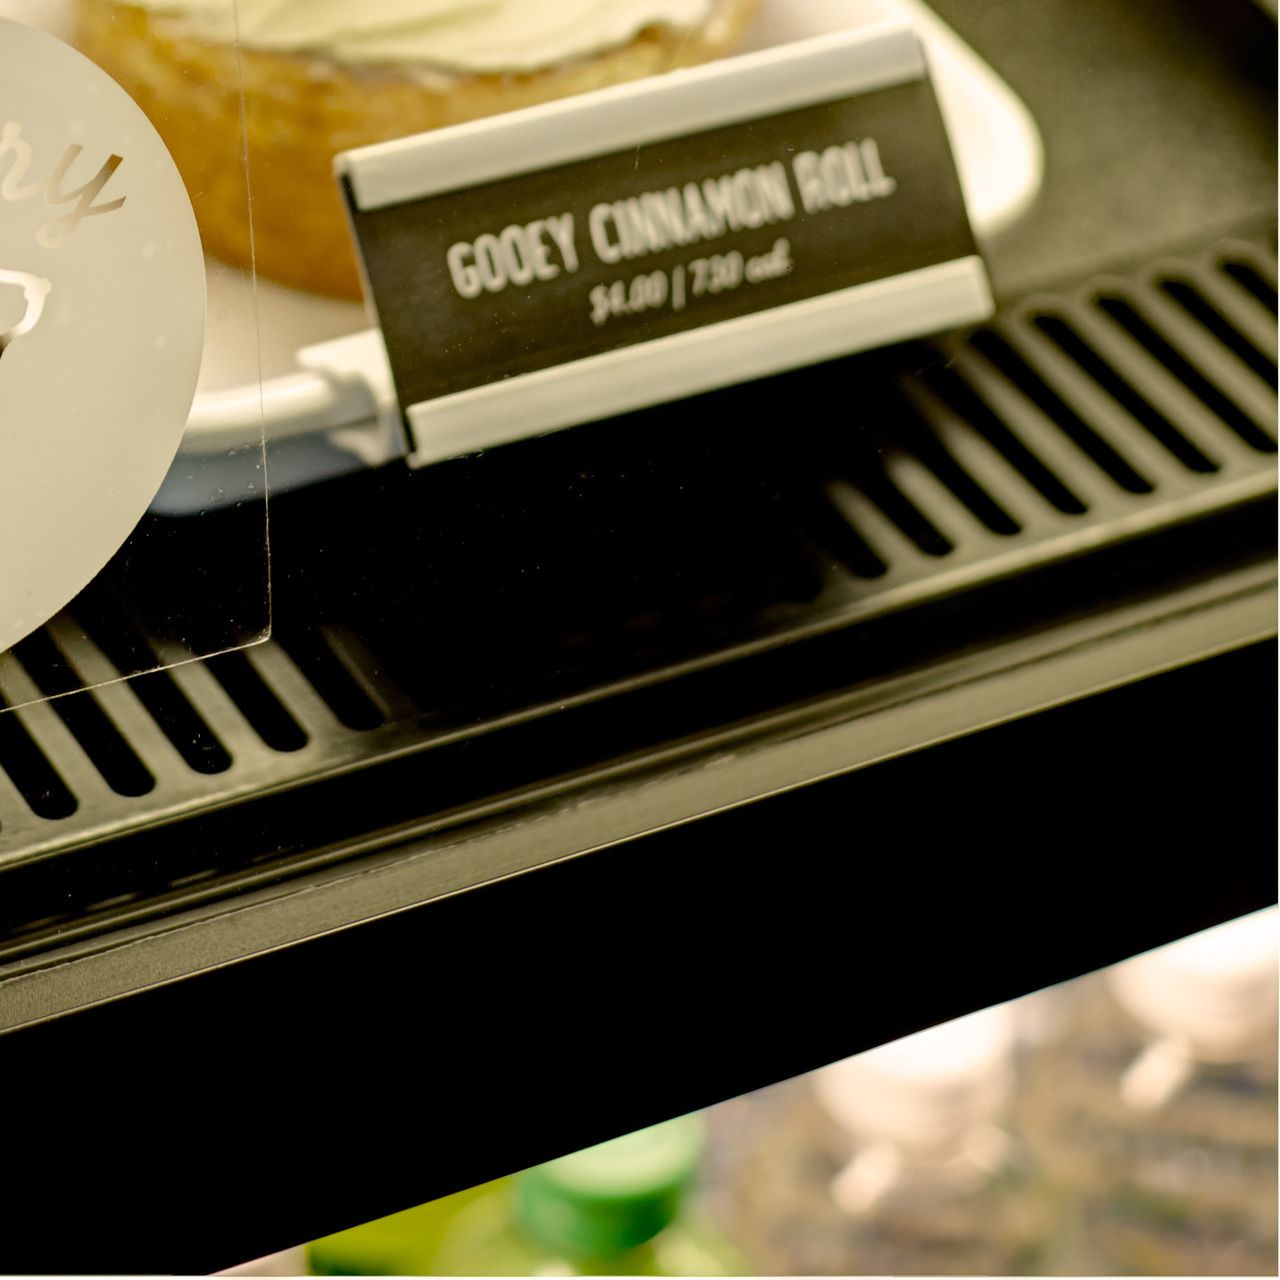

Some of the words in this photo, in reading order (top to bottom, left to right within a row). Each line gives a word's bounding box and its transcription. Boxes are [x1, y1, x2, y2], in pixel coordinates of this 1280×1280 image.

[446, 212, 580, 299] GOOEY
[588, 160, 795, 264] CINNAMON
[792, 137, 897, 214] ROLL
[746, 238, 793, 281] cal
